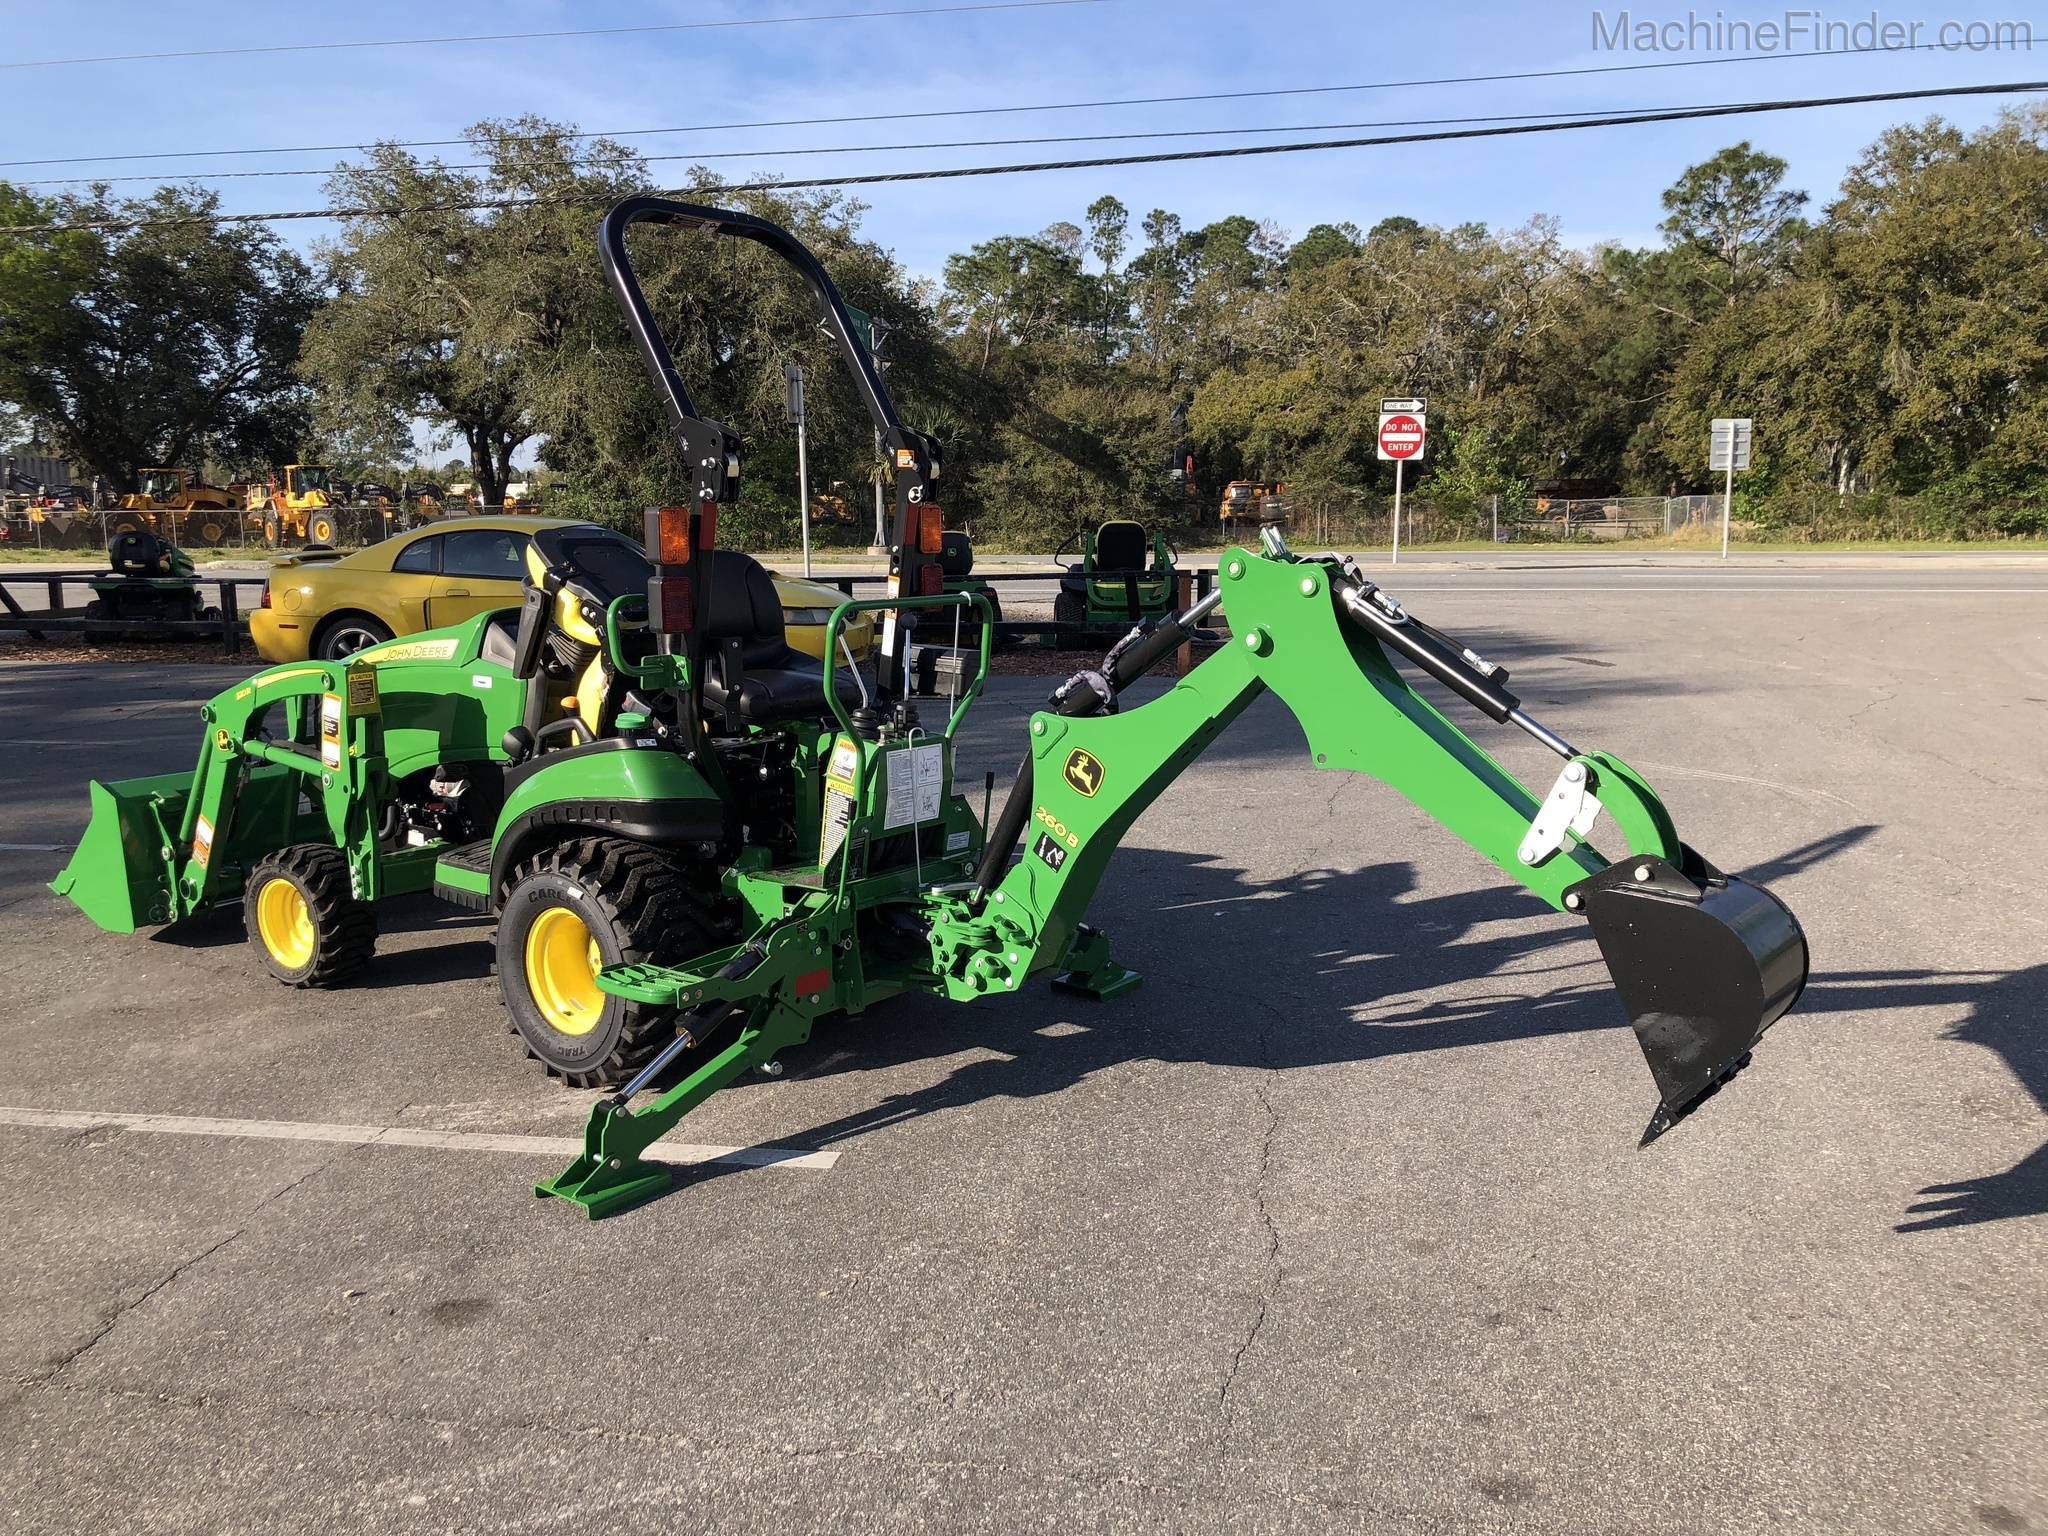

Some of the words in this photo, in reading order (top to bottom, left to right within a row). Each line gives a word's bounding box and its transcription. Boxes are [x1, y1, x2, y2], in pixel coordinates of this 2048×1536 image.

[1385, 423, 1397, 431] DO
[1401, 423, 1418, 431] NOT
[1387, 443, 1414, 451] ENTER
[384, 648, 412, 660] JOHN
[413, 645, 449, 657] DEERE
[1034, 805, 1066, 837] 260
[1065, 831, 1080, 848] B
